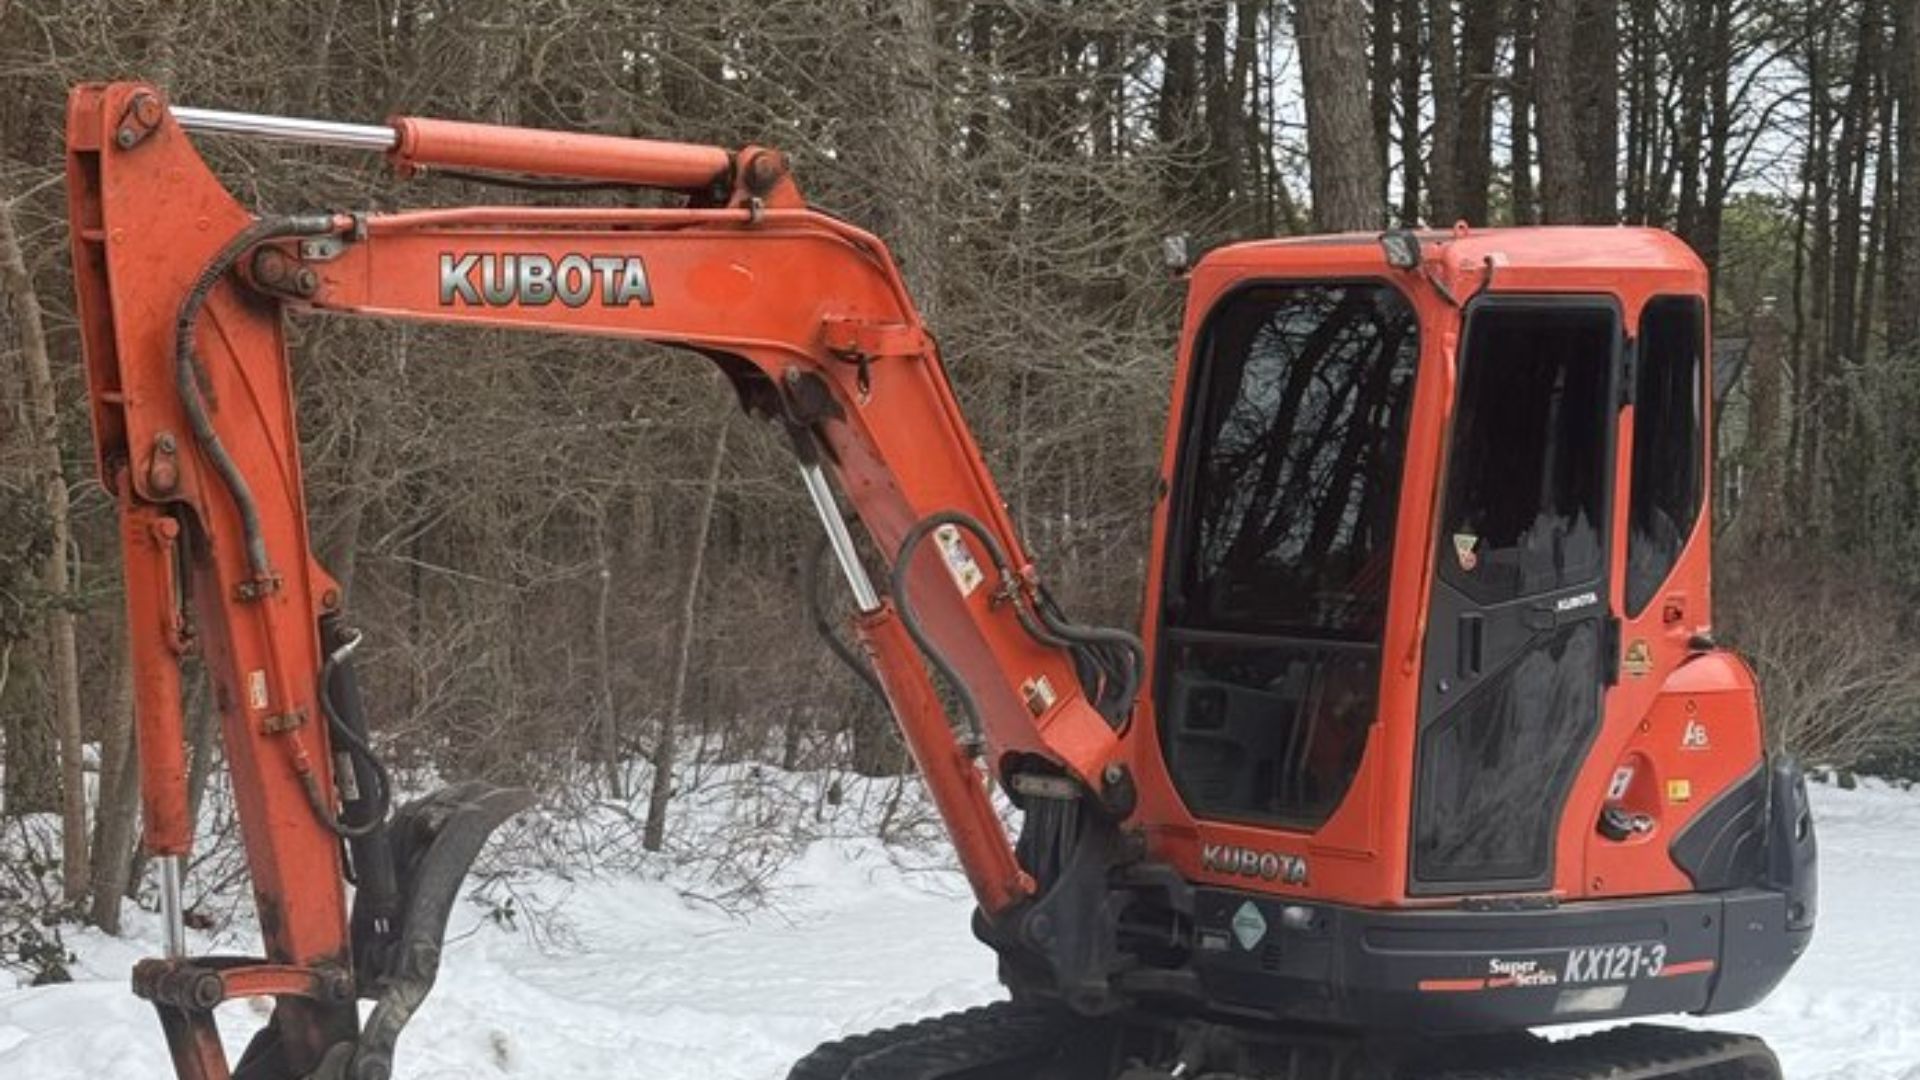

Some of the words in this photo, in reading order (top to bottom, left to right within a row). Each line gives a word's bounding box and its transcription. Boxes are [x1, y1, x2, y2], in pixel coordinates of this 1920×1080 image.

[438, 252, 654, 308] KUBOTA
[1202, 843, 1310, 887] KUBOTA
[1489, 958, 1537, 977] Super
[1516, 969, 1558, 986] Series
[1563, 944, 1667, 983] KX121-3
